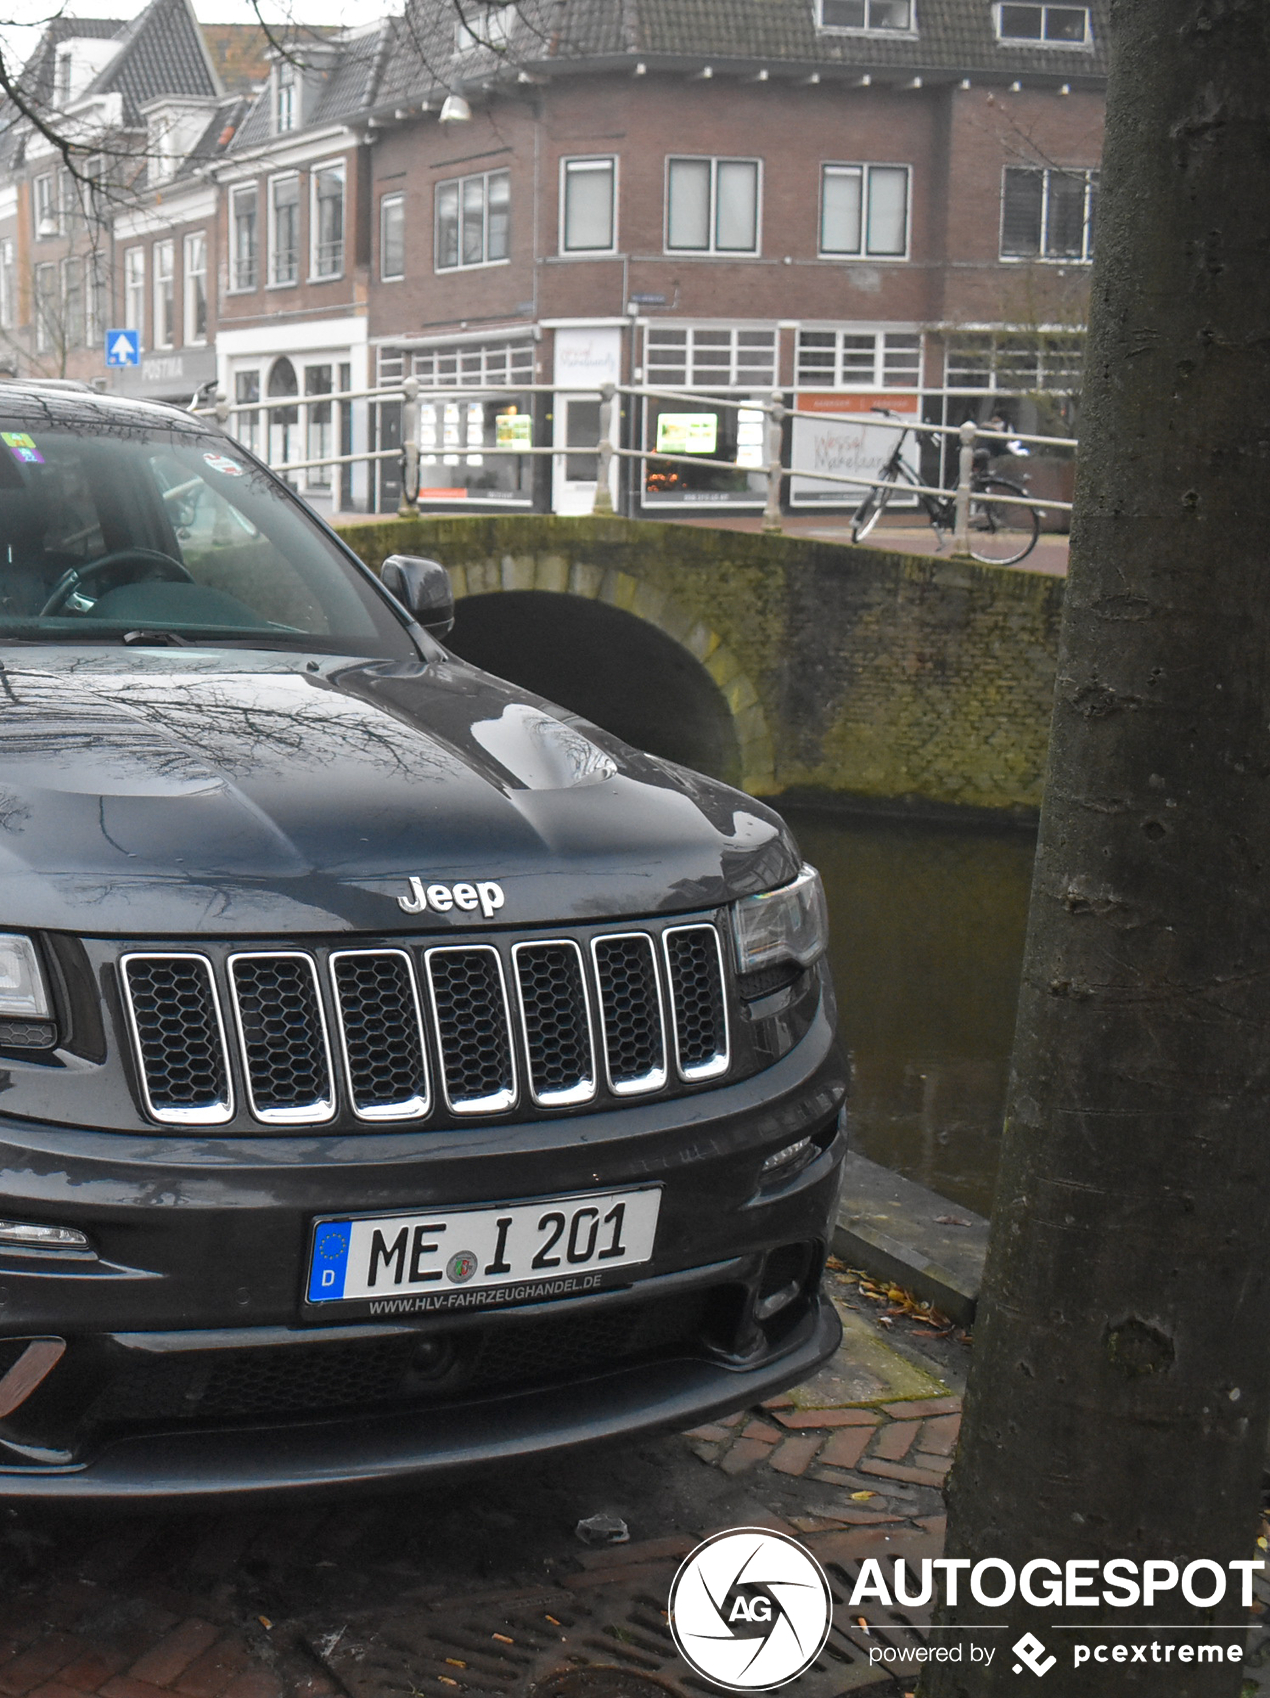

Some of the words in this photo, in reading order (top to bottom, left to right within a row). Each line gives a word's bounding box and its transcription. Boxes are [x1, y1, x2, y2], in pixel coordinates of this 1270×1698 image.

[397, 876, 505, 918] Jeep
[367, 1222, 447, 1287] ME
[484, 1216, 513, 1276] I
[531, 1202, 626, 1270] 201
[321, 1269, 335, 1287] D
[369, 1274, 603, 1315] WWW.HLV-FAHRZEUGHANDEL.DE
